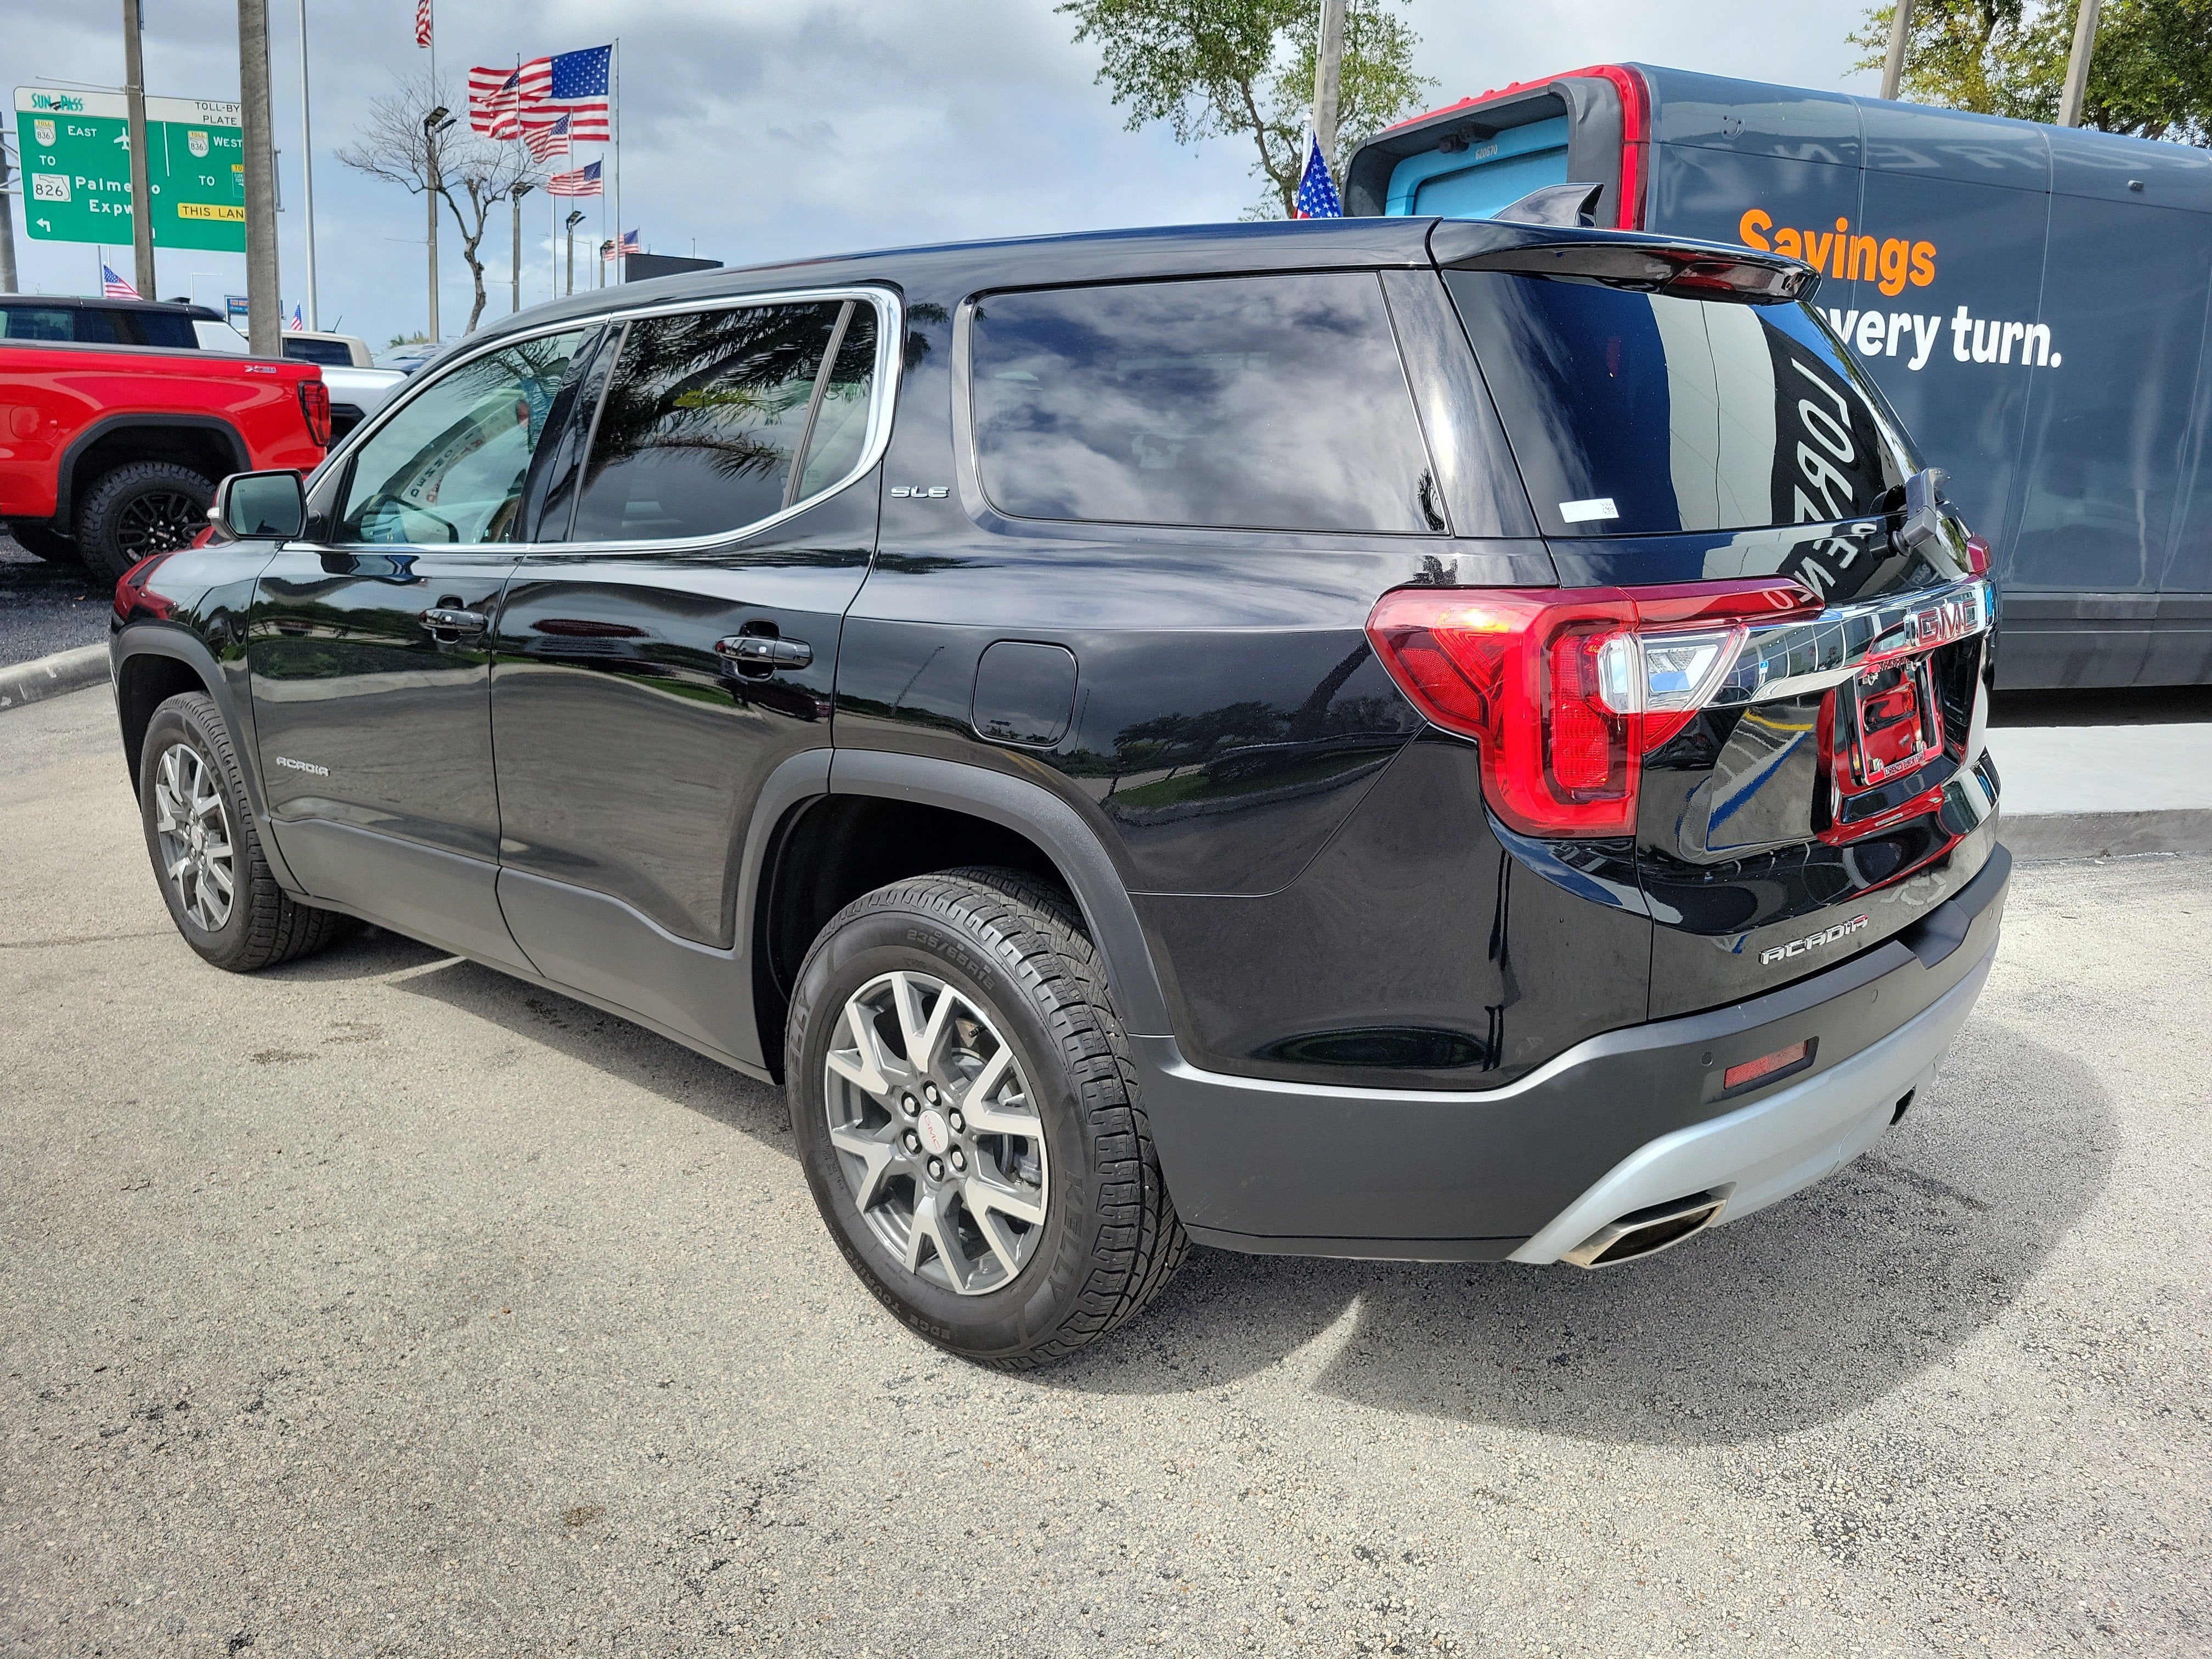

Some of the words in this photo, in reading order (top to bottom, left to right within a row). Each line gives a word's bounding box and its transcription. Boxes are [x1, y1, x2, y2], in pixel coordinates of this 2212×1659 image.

[195, 101, 240, 113] TOLL-BY
[203, 115, 237, 126] PLATE
[67, 125, 97, 137] EAST
[191, 143, 204, 151] 836
[213, 136, 242, 148] WEST
[39, 155, 56, 166] TO
[75, 176, 161, 195] Palmeo
[198, 175, 215, 187] TO
[36, 184, 63, 196] 826
[89, 199, 133, 217] Expw
[183, 206, 211, 217] THIS
[218, 208, 244, 219] LAN
[1739, 209, 1937, 296] Savings
[1951, 305, 2062, 369] turn.
[891, 486, 949, 498] SLE
[1916, 597, 1978, 645] GMC
[276, 756, 330, 777] ACADIA
[1759, 914, 1868, 964] ACADIA
[924, 1115, 941, 1150] GMC
